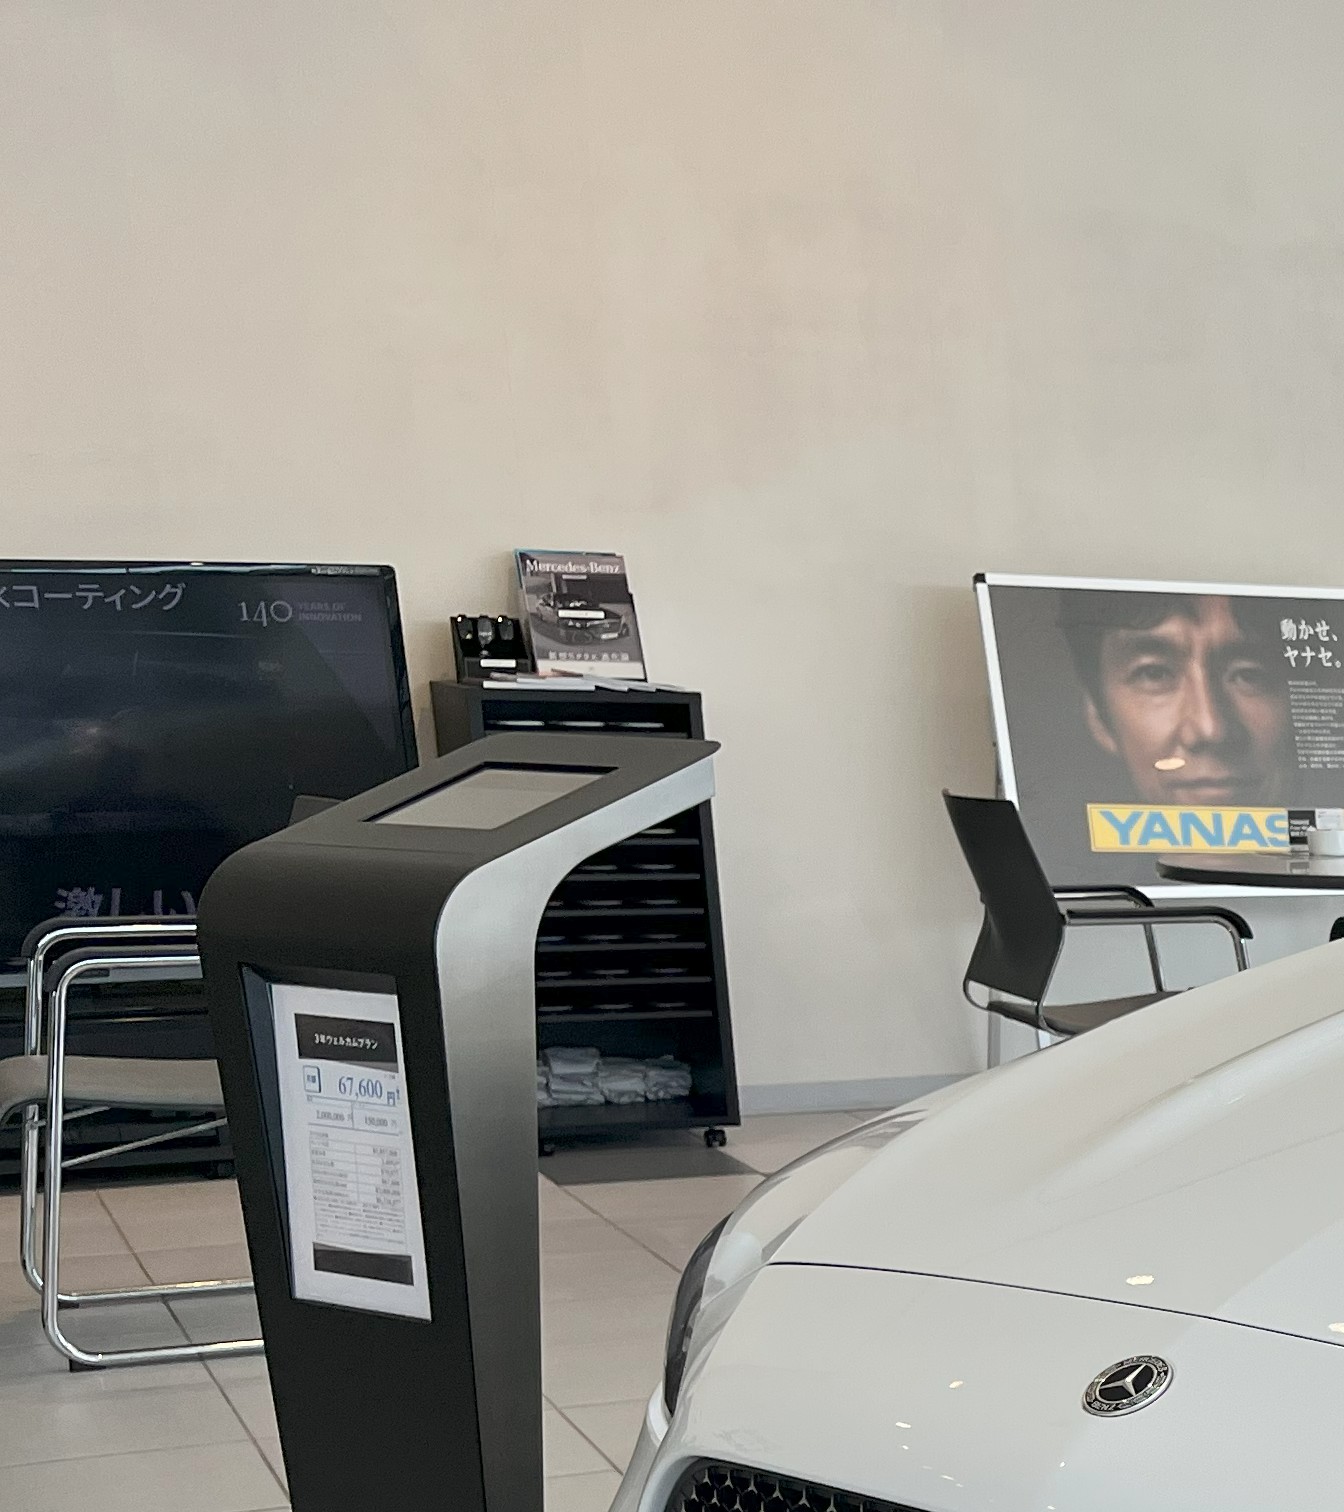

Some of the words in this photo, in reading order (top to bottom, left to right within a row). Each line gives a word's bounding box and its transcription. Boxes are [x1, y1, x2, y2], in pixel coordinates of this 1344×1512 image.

[526, 558, 621, 574] Mercedes-Benz
[238, 600, 293, 627] 140
[1280, 618, 1338, 642] 動かせ、
[1284, 645, 1342, 668] ヤナセ。
[1100, 810, 1289, 848] YANAS
[338, 1075, 383, 1100] 67,600
